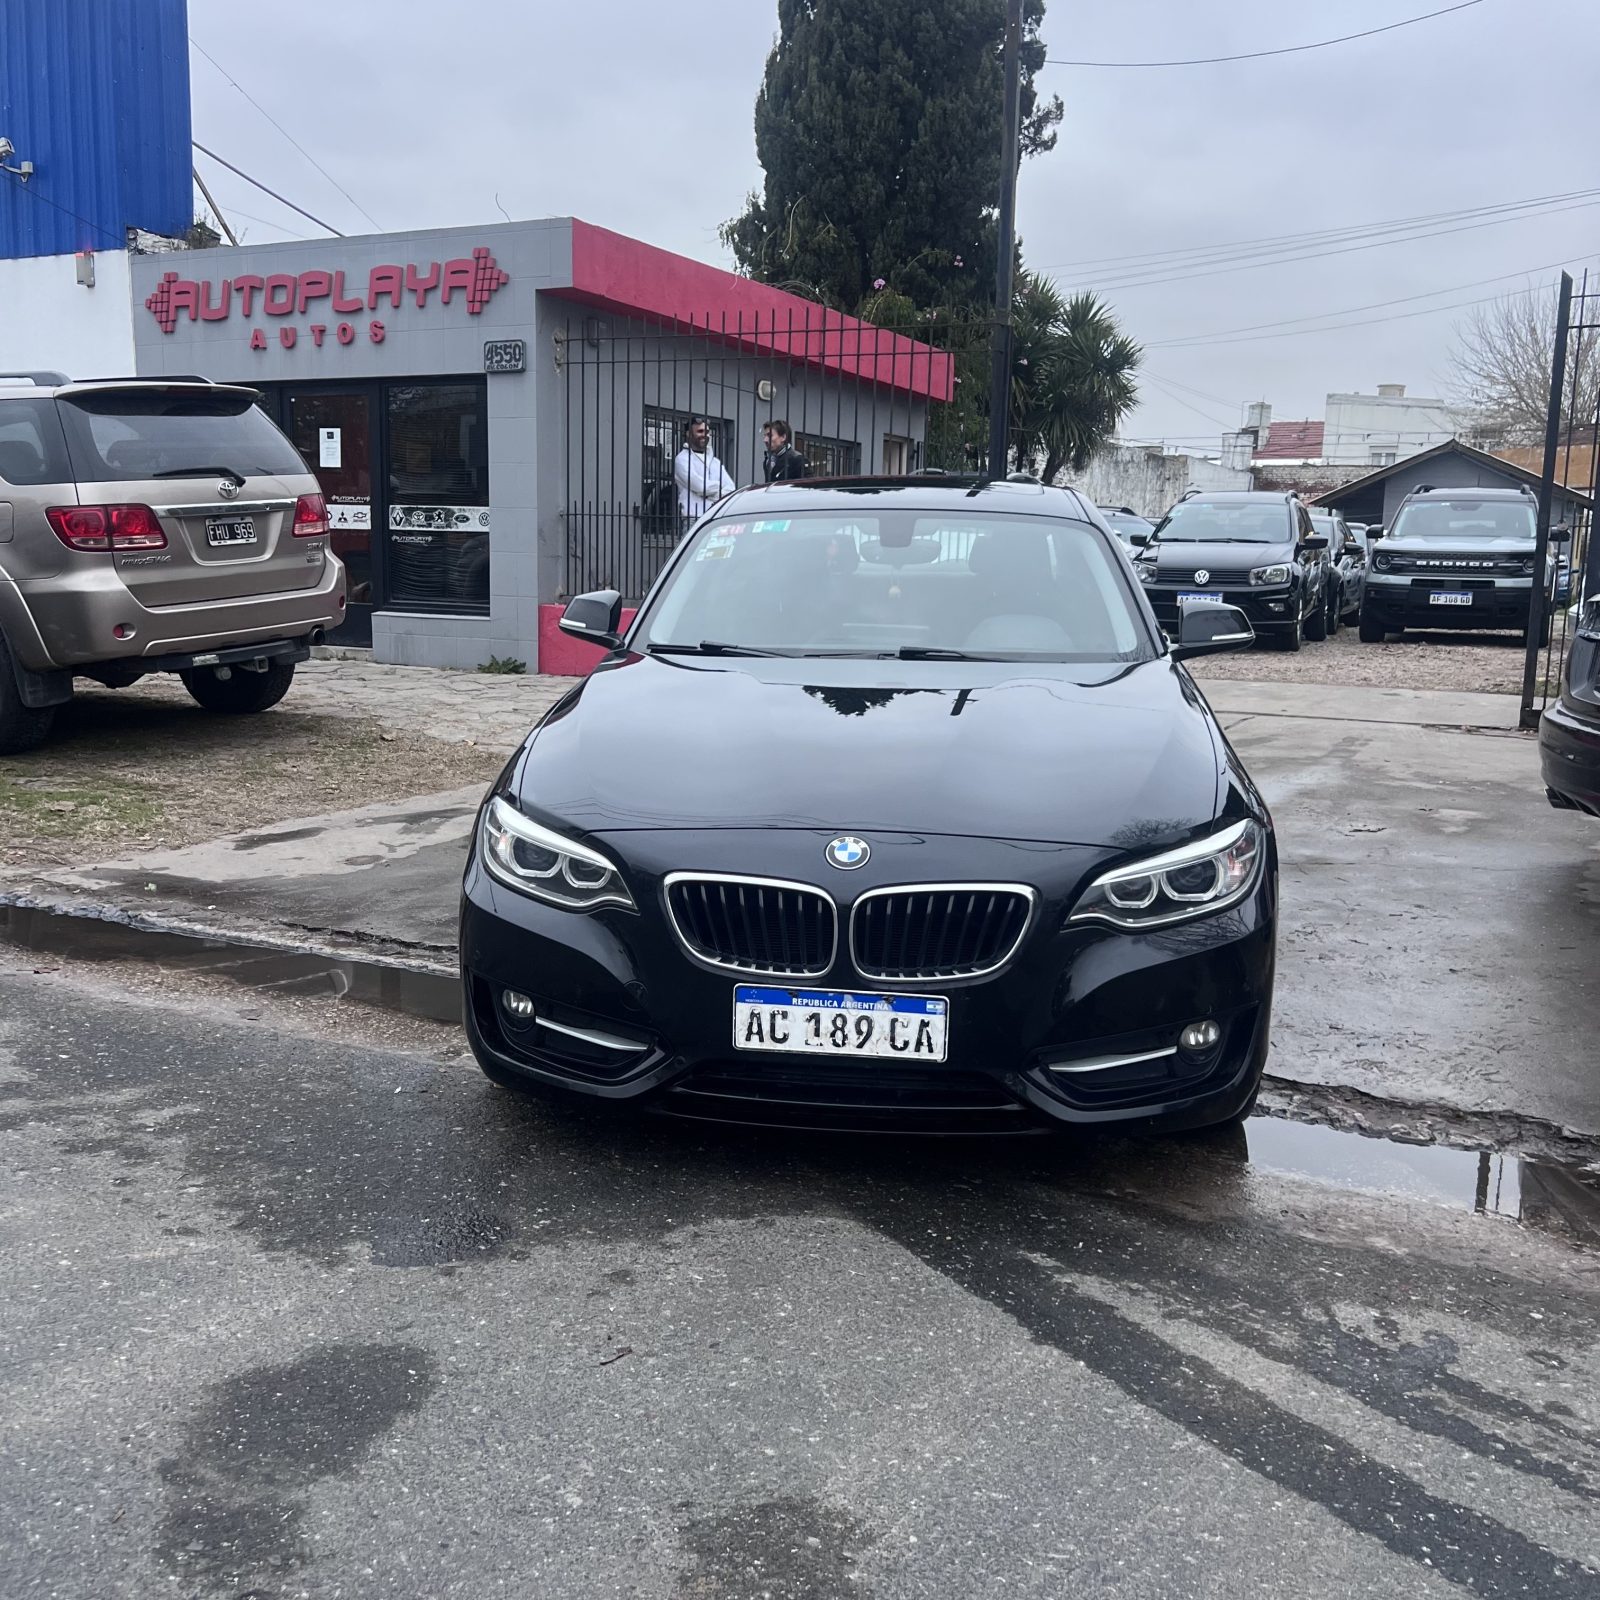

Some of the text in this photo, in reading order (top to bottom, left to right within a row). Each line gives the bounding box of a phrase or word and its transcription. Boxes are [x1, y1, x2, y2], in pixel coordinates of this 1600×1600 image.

[168, 258, 479, 321] AUTOPLAYA
[250, 319, 386, 350] AUTOS
[485, 343, 521, 364] 4550
[208, 523, 254, 540] FHU 969
[792, 997, 889, 1010] REPUBLICA ARGENTINA
[745, 1008, 934, 1053] AC 189 CA
